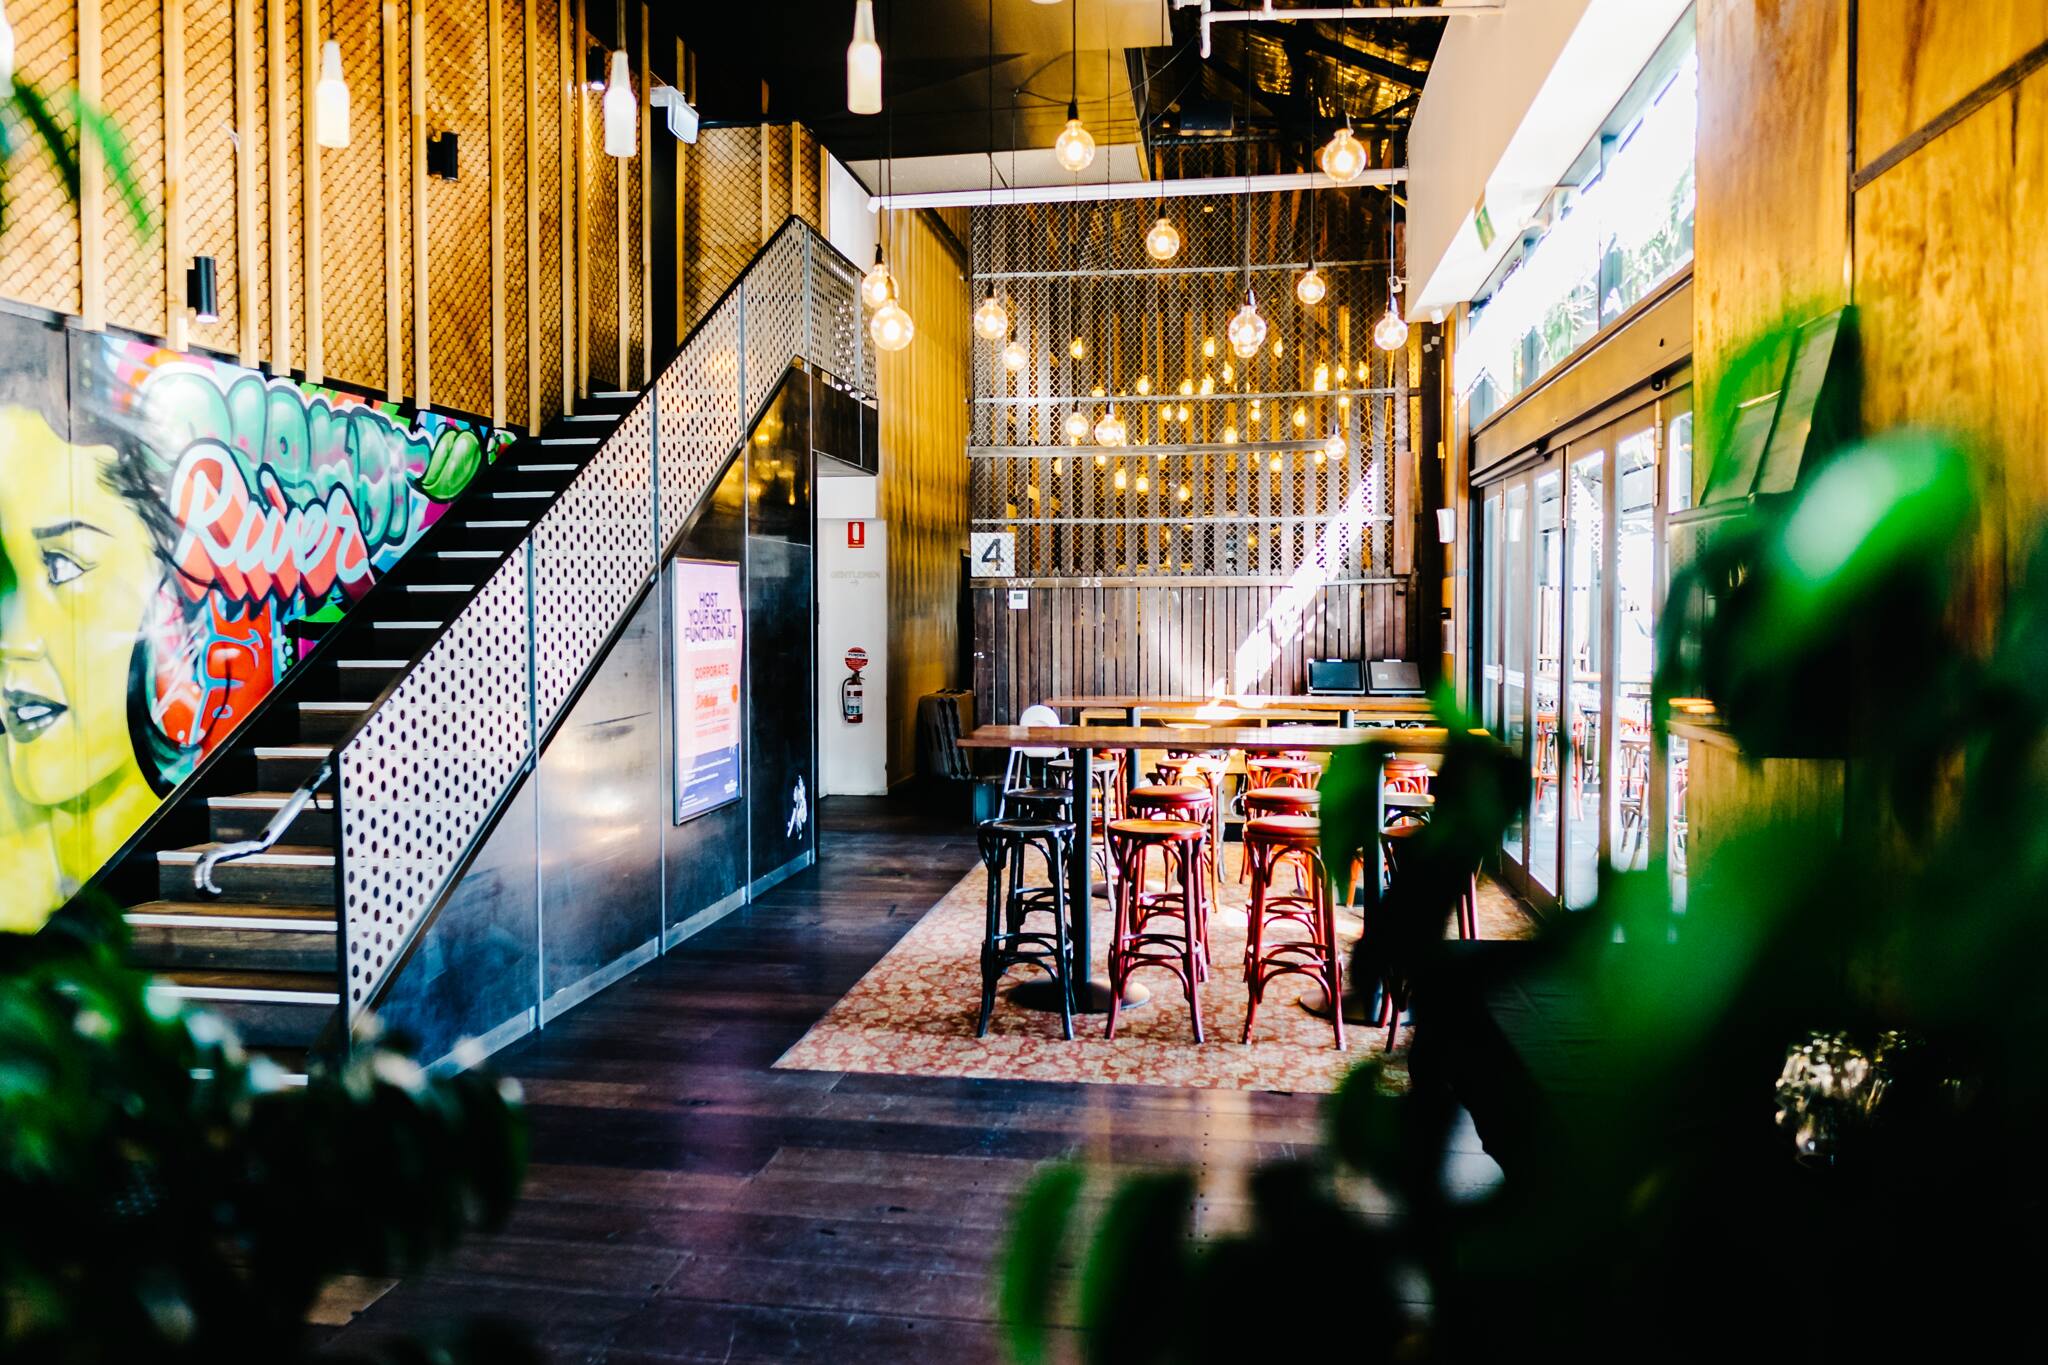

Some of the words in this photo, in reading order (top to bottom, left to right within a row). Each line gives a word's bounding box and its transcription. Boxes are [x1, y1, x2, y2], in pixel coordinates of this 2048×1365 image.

[169, 440, 373, 594] River
[981, 538, 1005, 571] 4
[699, 592, 718, 607] HOST
[688, 608, 710, 625] YOUR
[711, 608, 731, 624] NEXT
[684, 626, 724, 642] FUNCTION
[727, 625, 736, 640] AT
